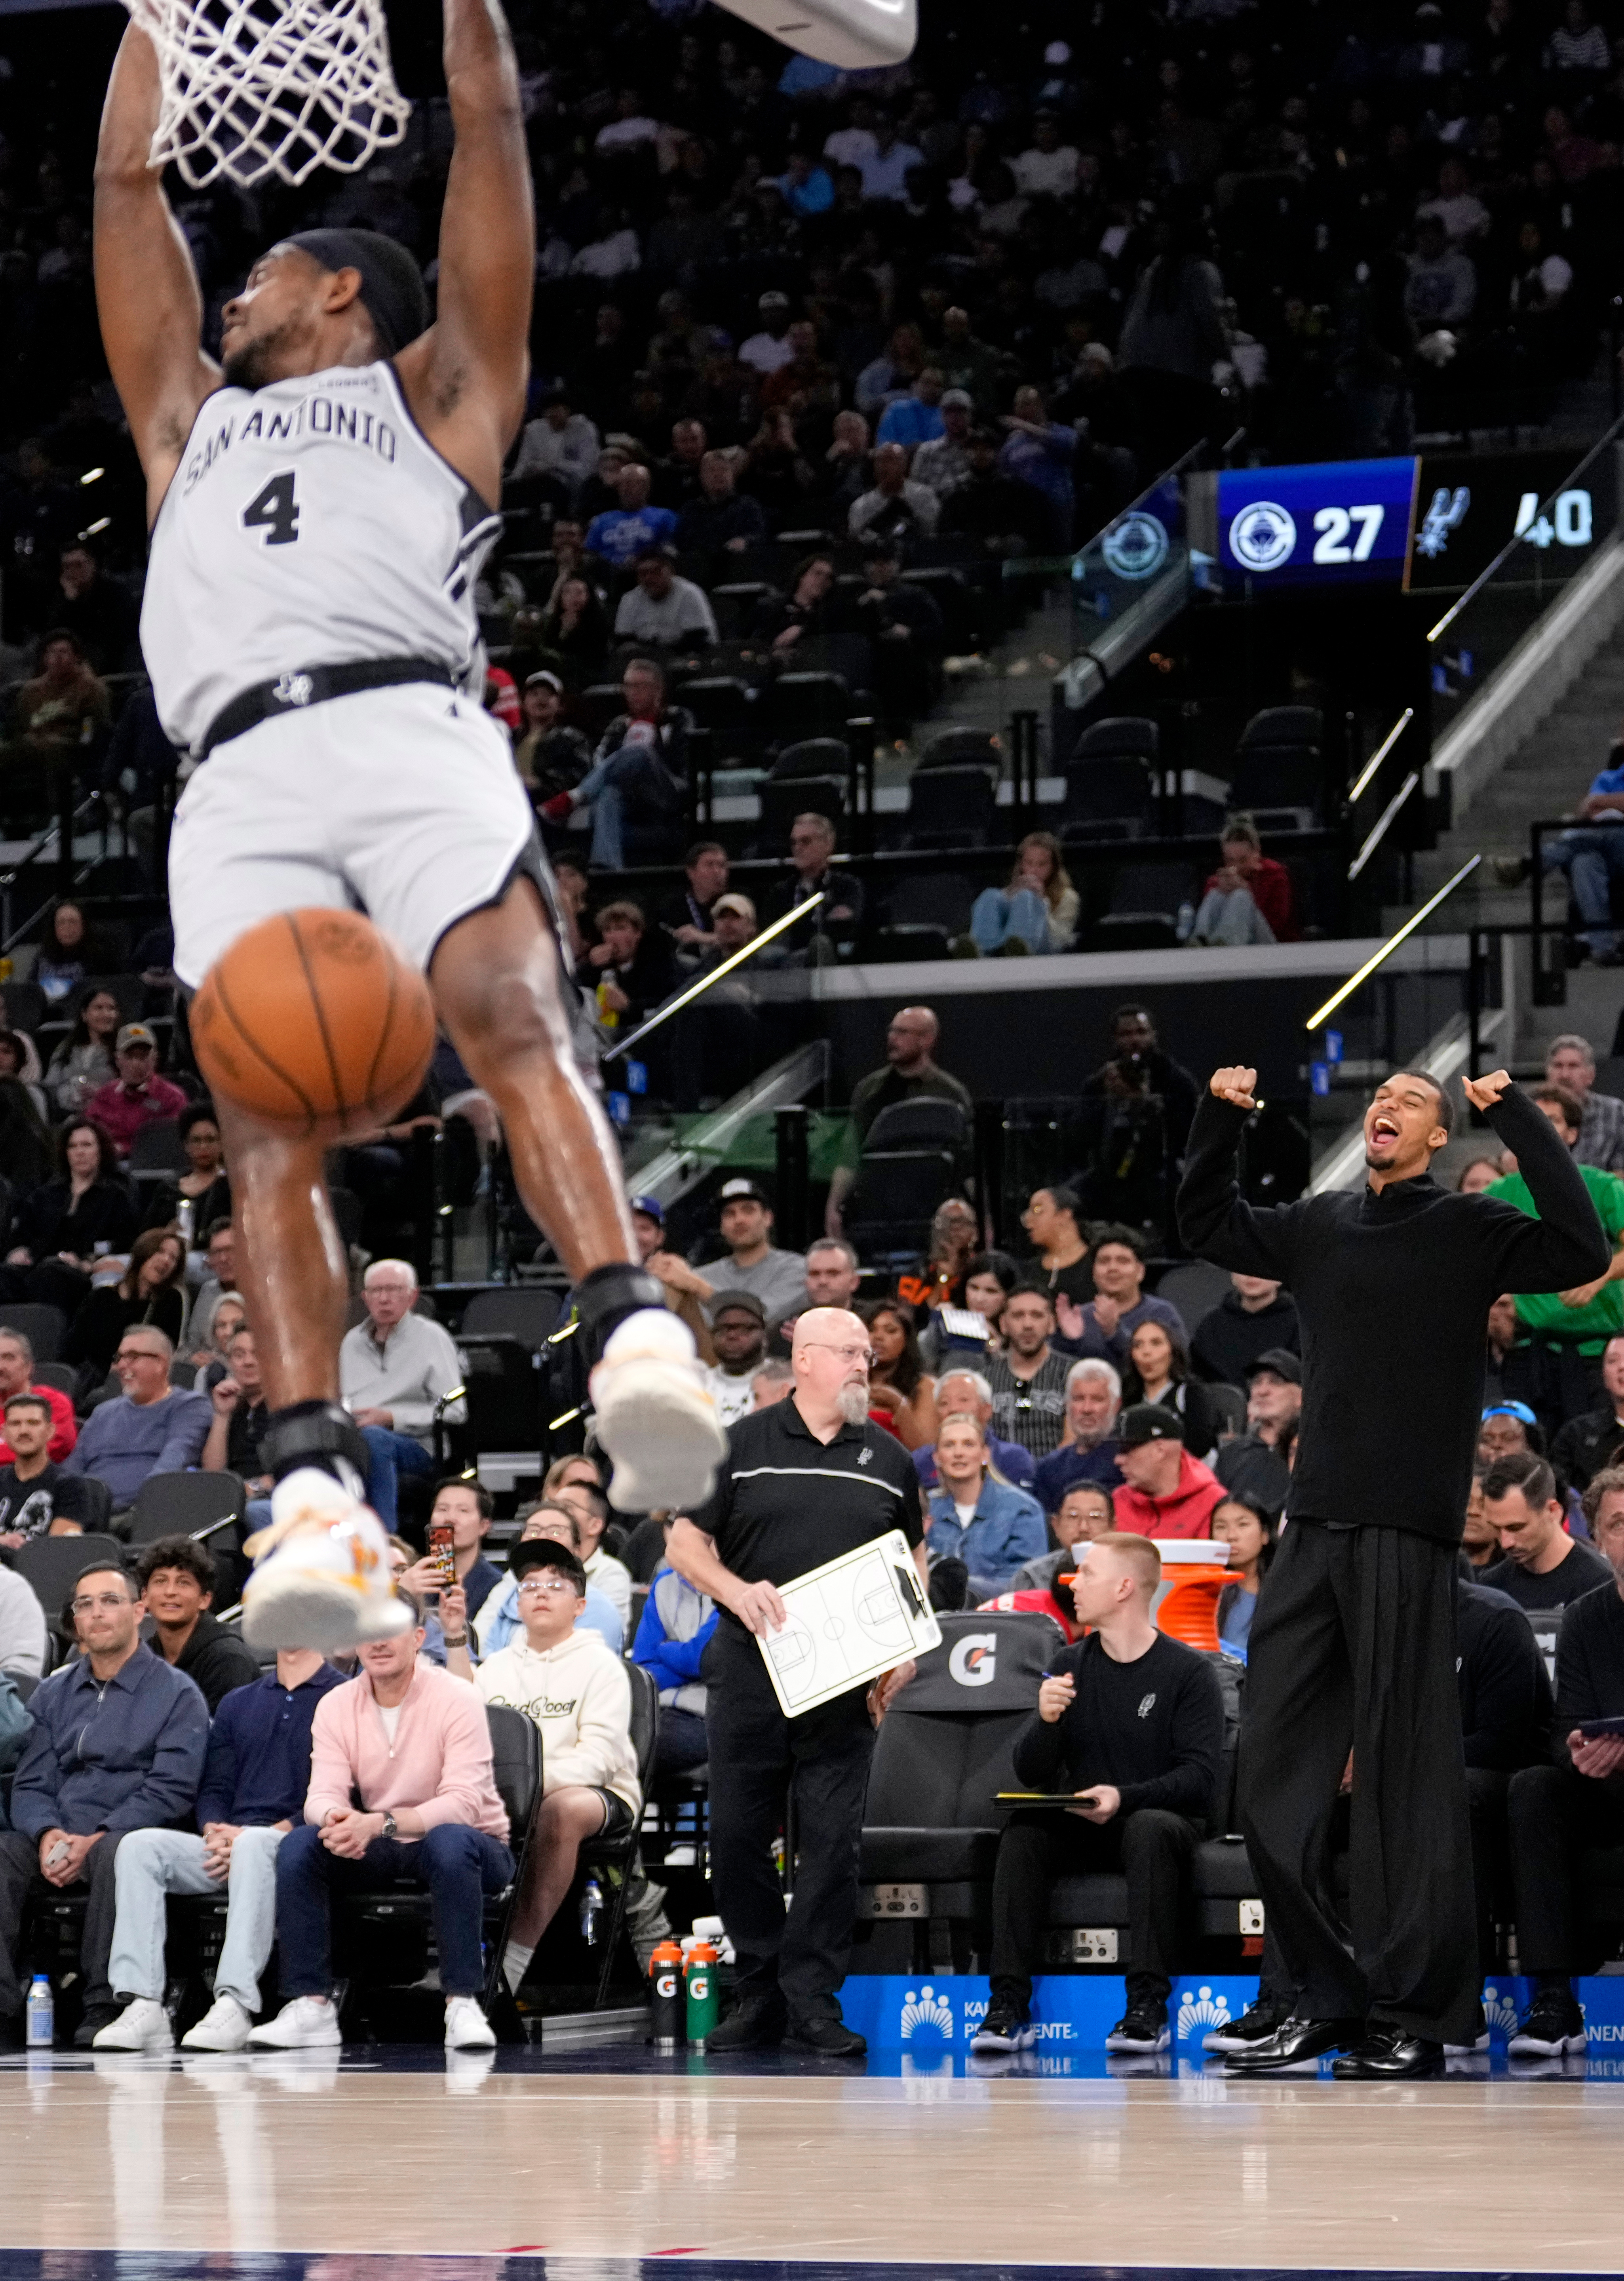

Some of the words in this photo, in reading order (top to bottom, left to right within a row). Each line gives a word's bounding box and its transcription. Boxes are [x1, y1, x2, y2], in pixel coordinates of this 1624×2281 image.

[183, 414, 234, 499] SAN
[239, 397, 396, 464] ANTONIO
[243, 470, 300, 546] 4
[1313, 504, 1385, 565] 27
[1513, 489, 1592, 549] 40
[949, 1633, 996, 1687] G
[656, 1974, 677, 1998] G
[690, 1977, 709, 2000] G
[964, 2001, 989, 2017] KAI
